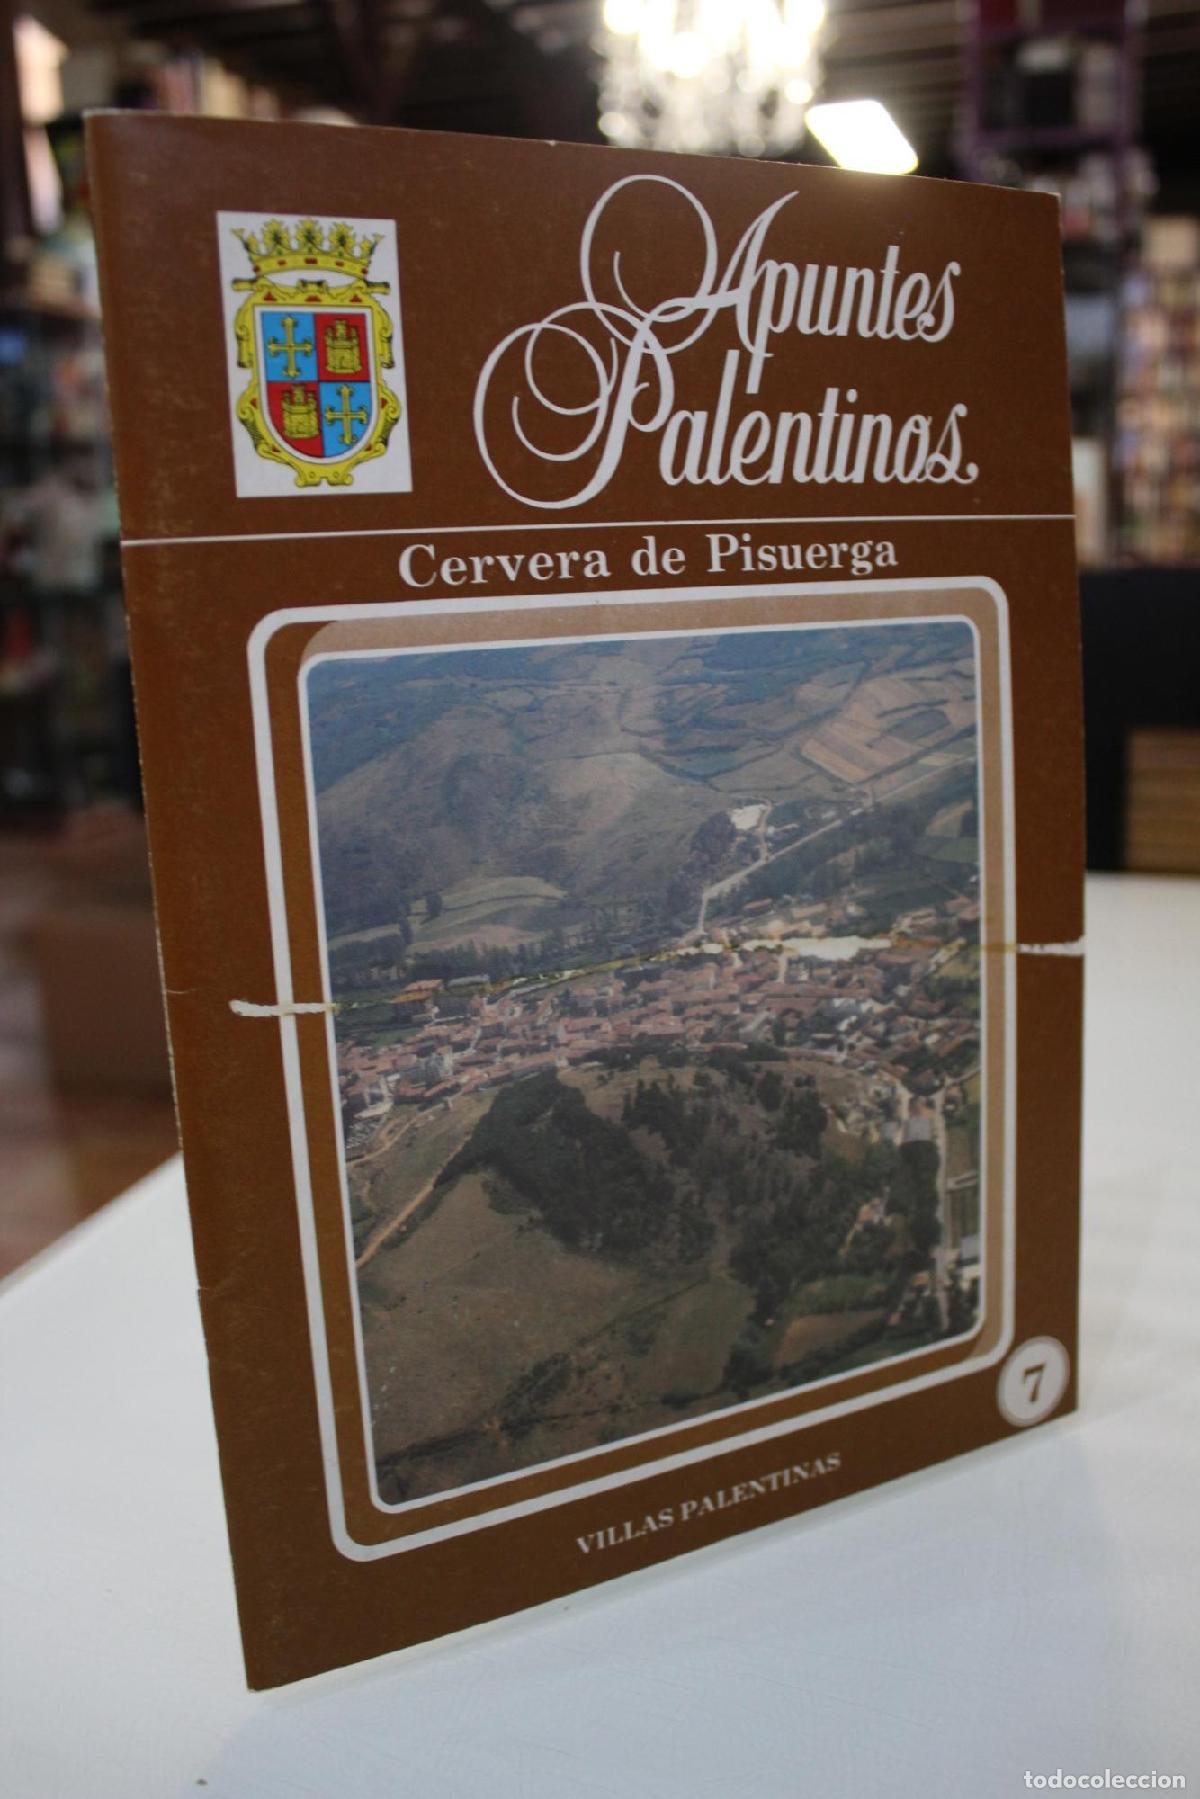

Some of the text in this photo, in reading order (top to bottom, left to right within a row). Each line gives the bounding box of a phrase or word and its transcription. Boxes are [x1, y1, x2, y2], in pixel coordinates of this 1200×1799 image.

[580, 174, 961, 393] Apuntes
[397, 532, 898, 588] Cervera de Pisuerga
[1020, 1363, 1047, 1402] 7
[575, 1452, 842, 1555] VILLAS PALENTINAS
